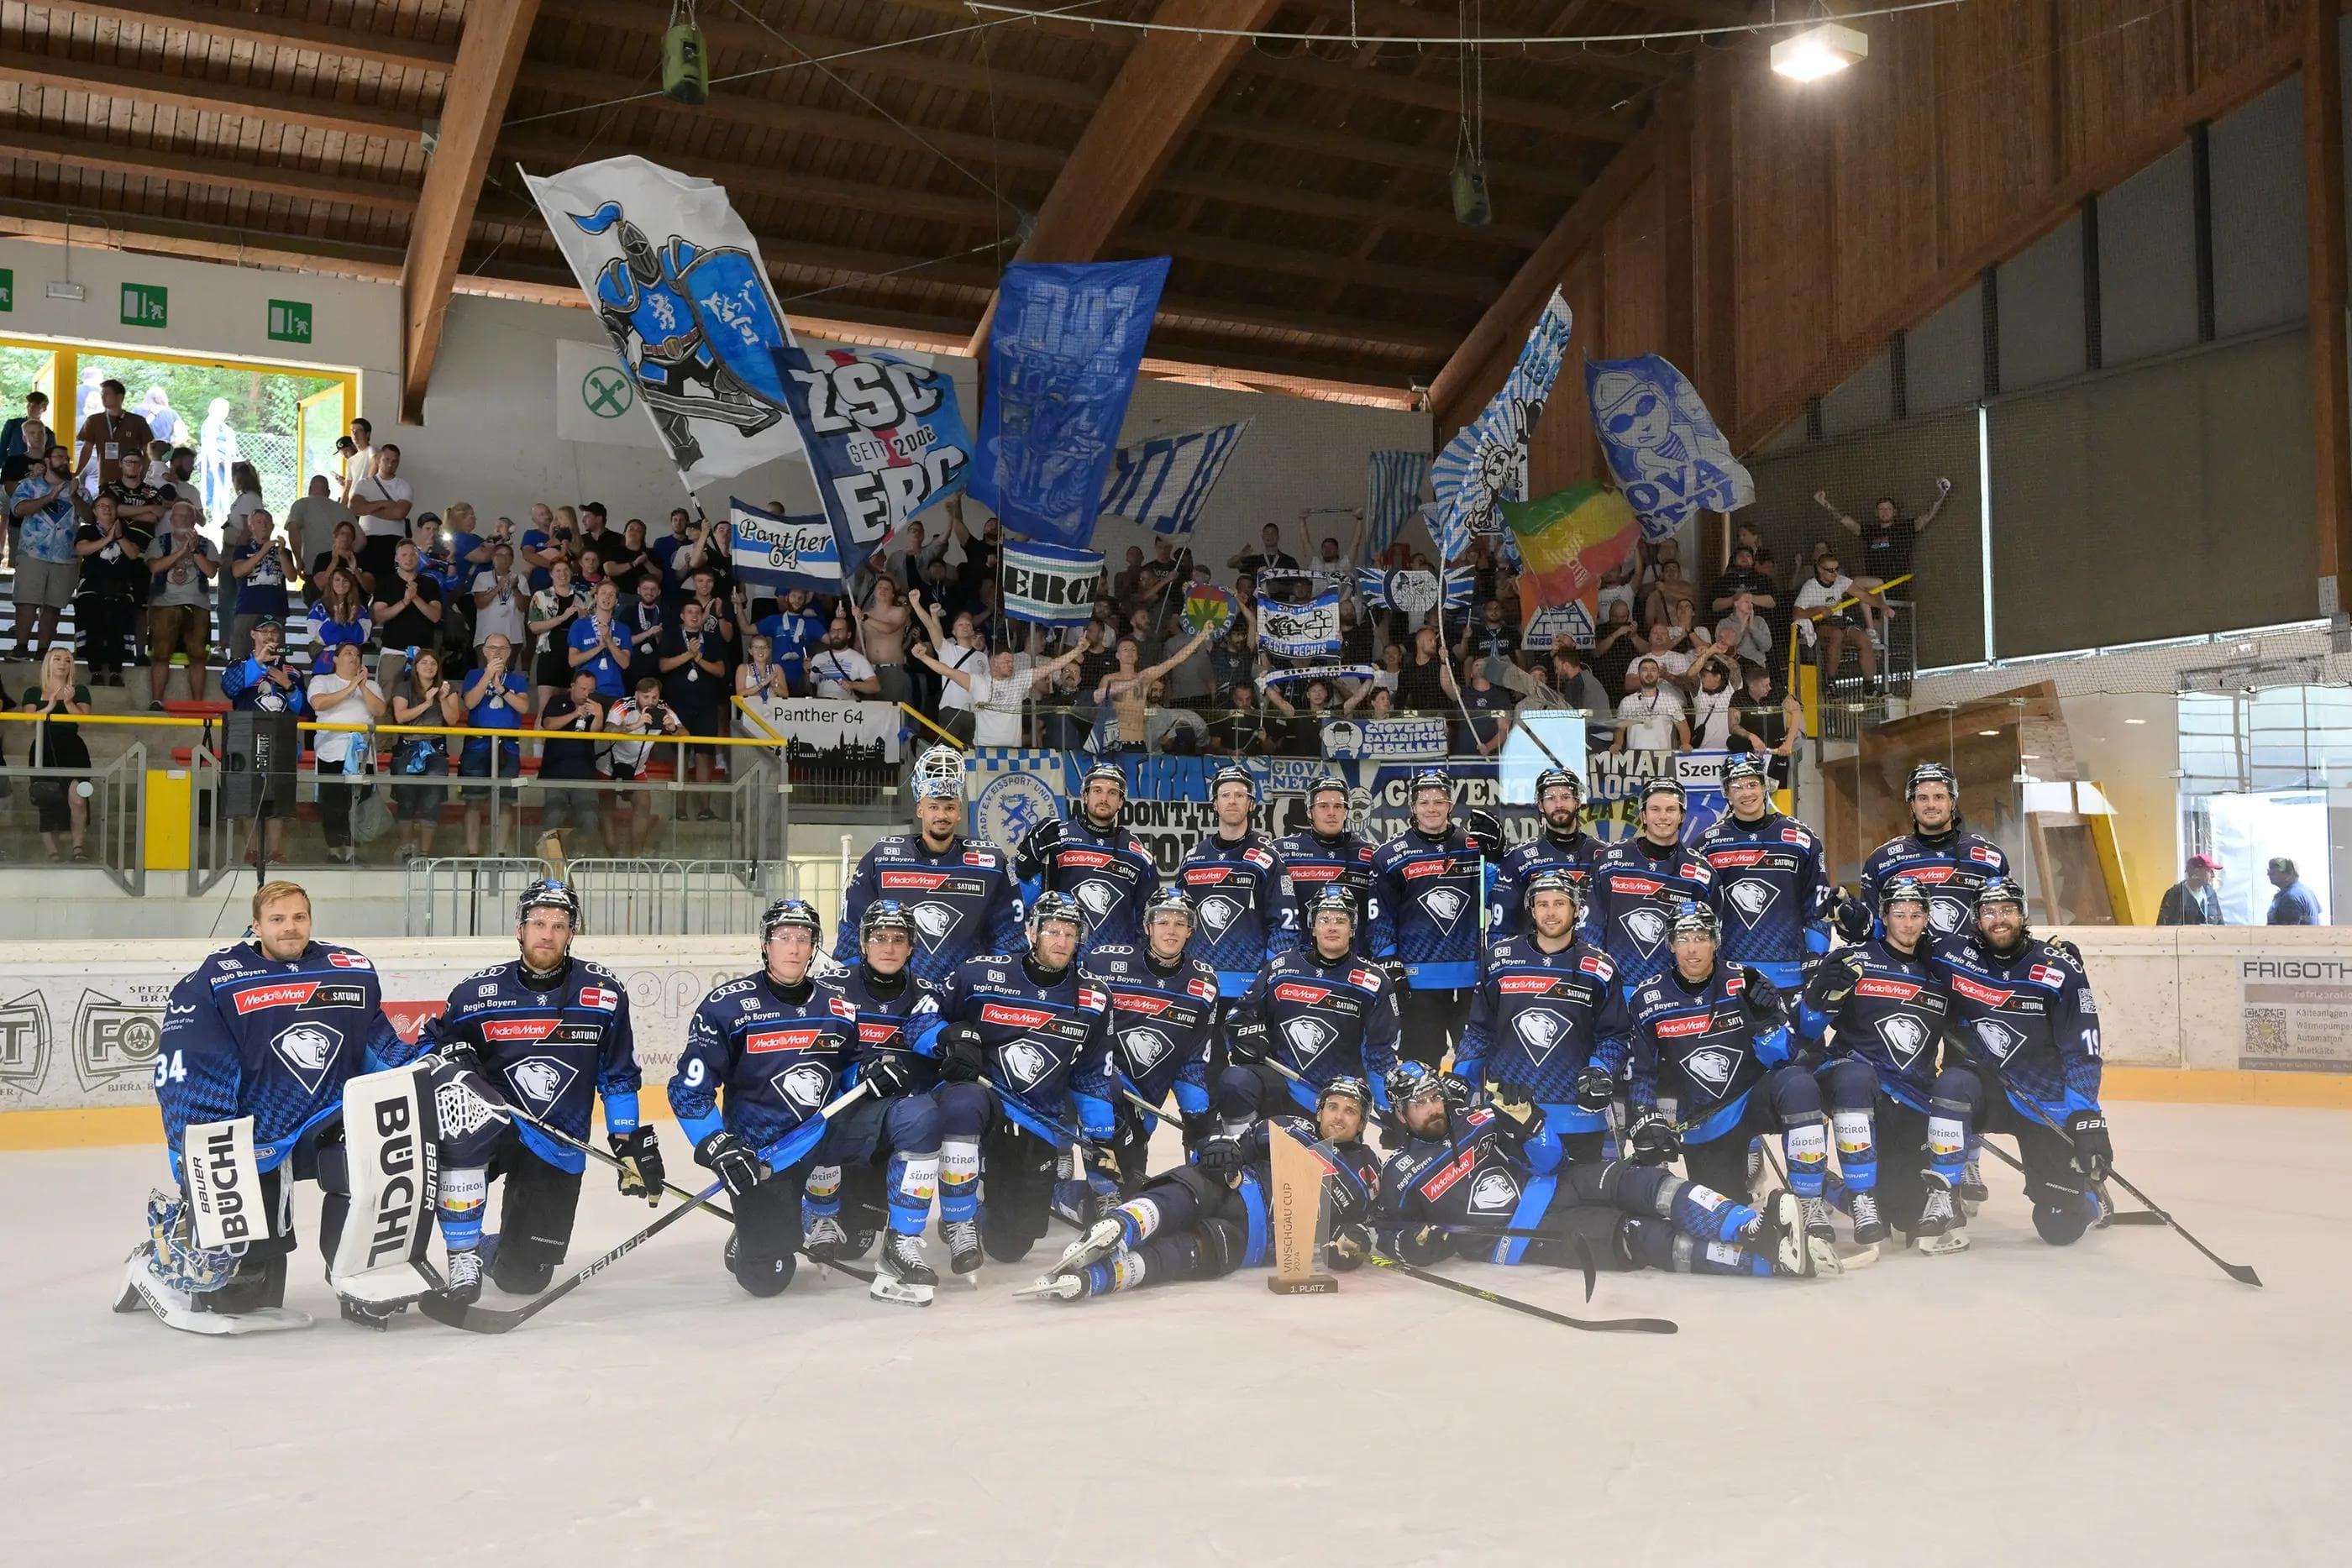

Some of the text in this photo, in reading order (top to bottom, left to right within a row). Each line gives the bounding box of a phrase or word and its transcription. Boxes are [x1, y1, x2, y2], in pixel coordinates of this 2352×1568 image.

[739, 519, 833, 553] Panther
[769, 546, 798, 569] 64
[774, 706, 864, 724] Panther 64
[1501, 957, 1527, 966] Bayern
[1945, 952, 1966, 965] Regio
[210, 968, 268, 986] Regio Bayern
[1116, 975, 1142, 985] Bayern
[332, 990, 361, 1003] SATURN
[479, 984, 496, 996] DB
[993, 984, 1021, 996] Bayern
[1566, 989, 1591, 1001] SATURN
[1644, 990, 1661, 1004] DB
[463, 998, 517, 1013] Regio Bayern
[1654, 1000, 1680, 1012] Bayern
[753, 1009, 781, 1022] Bayern
[155, 1049, 187, 1088] 34
[683, 1057, 706, 1088] 9
[614, 1119, 636, 1127] ERC
[1396, 1155, 1434, 1192] Regio Bayern
[207, 1124, 250, 1240] BÜCHL
[366, 1094, 414, 1268] BÜCHL
[1283, 1182, 1293, 1274] VINSCHGAU CUP
[775, 1259, 784, 1272] 9
[1299, 1284, 1325, 1293] PLATZ
